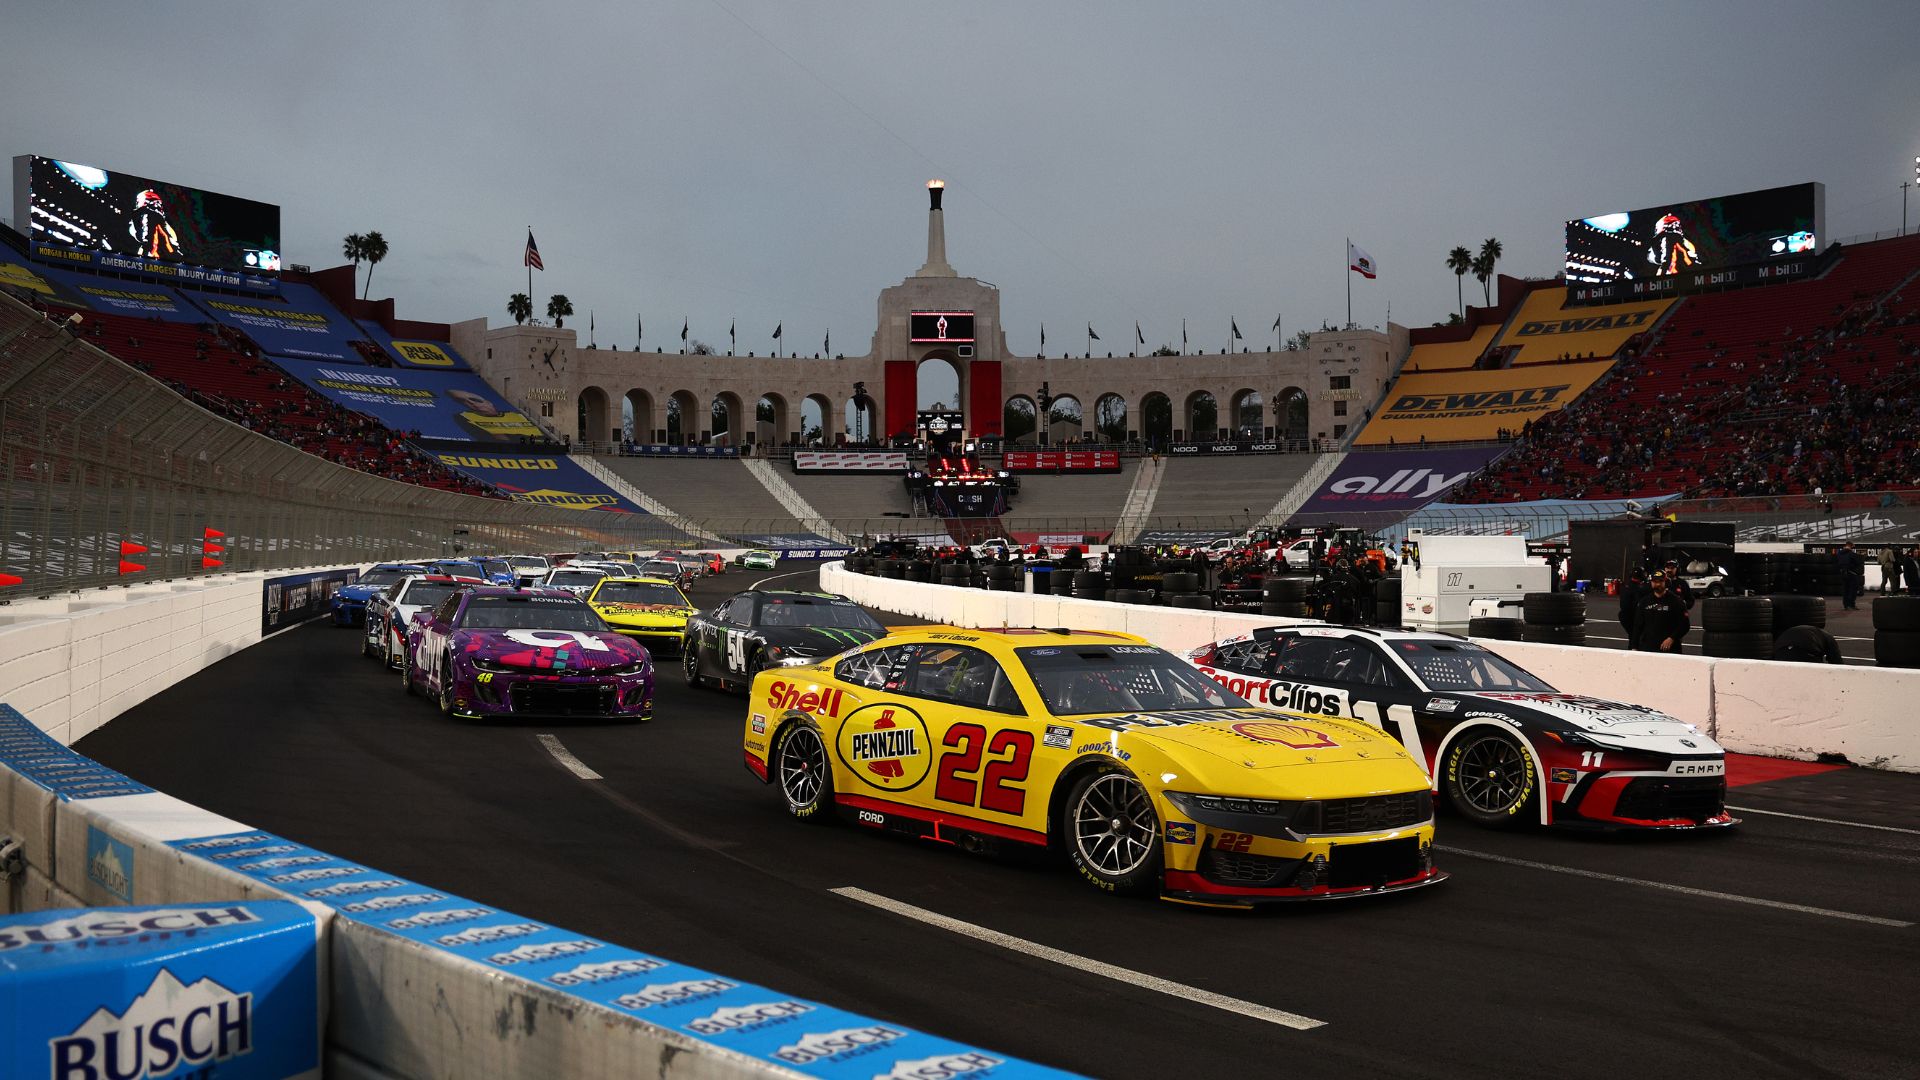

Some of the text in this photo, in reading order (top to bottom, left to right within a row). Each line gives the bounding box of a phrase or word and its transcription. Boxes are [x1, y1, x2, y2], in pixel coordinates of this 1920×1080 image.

[68, 251, 91, 262] MORGAN
[100, 257, 143, 271] AMERICA'S
[144, 264, 177, 276] LARGEST
[178, 268, 204, 280] INJURY
[206, 272, 221, 282] LAW
[222, 275, 240, 285] FIRM
[317, 368, 400, 387] INJURED?
[1389, 384, 1571, 412] DEWALT
[1380, 405, 1482, 421] GUARANTEED
[438, 455, 558, 470] SUNOCO
[1330, 468, 1476, 498] ally
[512, 494, 614, 504] SUNOCO
[788, 550, 816, 558] SUNOCO
[819, 550, 849, 558] SUNOCO
[1447, 573, 1462, 586] 11
[1481, 608, 1488, 616] 11
[948, 634, 980, 642] LOGANO
[727, 630, 748, 675] 54
[1110, 646, 1161, 654] LOGANO
[476, 672, 493, 684] 48
[768, 681, 844, 718] Shell
[1464, 711, 1523, 728] GOODYEAR
[852, 730, 918, 760] PENNZOIL
[934, 722, 1035, 817] 22
[1448, 746, 1462, 782] EAGLE
[1581, 751, 1604, 768] 11
[1675, 764, 1723, 774] CAMRY
[1508, 746, 1534, 815] GOODYEAR
[796, 802, 818, 816] EAGLE
[858, 810, 884, 824] FORD
[1167, 829, 1195, 838] SUNOCO
[1216, 832, 1254, 852] 22
[1079, 865, 1114, 892] EAGLE
[305, 880, 403, 898] BUSCH
[343, 894, 444, 912] BUSCH
[388, 907, 493, 929] BUSCH
[437, 923, 545, 946] BUSCH
[487, 940, 599, 965] BUSCH
[549, 958, 667, 986] BUSCH
[617, 979, 734, 1009] BUSCH
[661, 992, 722, 1008] LIGHT
[688, 1001, 811, 1035] BUSCH
[736, 1014, 800, 1034] LIGHT
[53, 996, 249, 1080] BUSCH
[777, 1026, 903, 1064] BUSCH
[830, 1040, 896, 1064] LIGHT
[888, 1053, 1001, 1080] USCH
